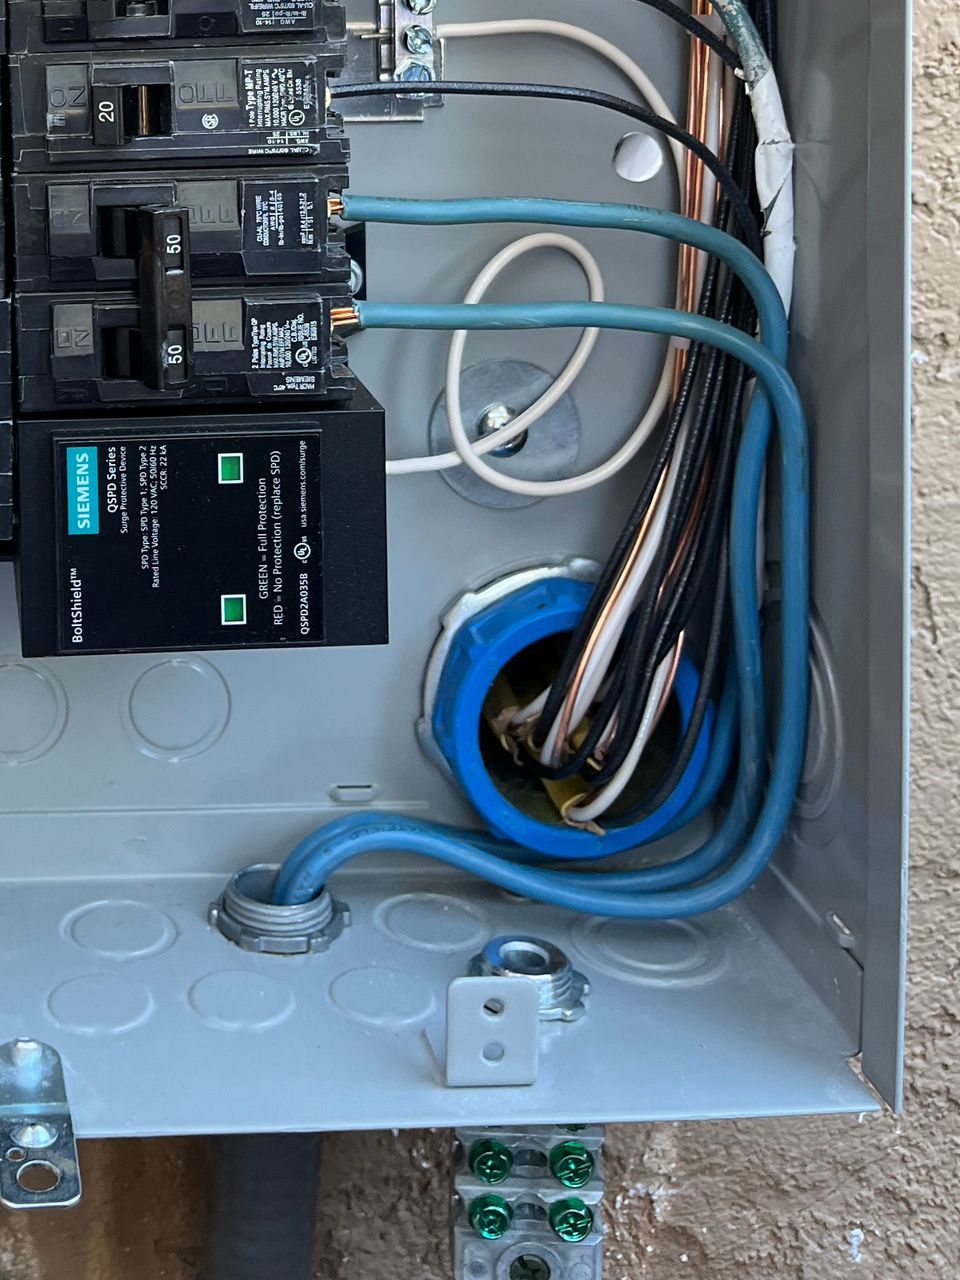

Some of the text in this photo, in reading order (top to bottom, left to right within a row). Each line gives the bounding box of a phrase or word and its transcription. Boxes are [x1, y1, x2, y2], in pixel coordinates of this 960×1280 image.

[244, 70, 253, 89] MP-T
[246, 91, 257, 110] Type
[99, 102, 114, 122] 20
[167, 235, 181, 253] 50
[167, 344, 184, 366] 50
[150, 446, 156, 455] Hz
[160, 445, 166, 454] kA
[139, 453, 148, 470] Type
[160, 457, 167, 466] 22
[270, 451, 281, 474] SPD)
[106, 447, 118, 512] QSPD Series
[299, 441, 307, 527] usa.siemens.com/surge
[76, 453, 90, 528] SIEMENS
[271, 478, 283, 519] (replace
[140, 498, 149, 515] Type
[257, 478, 267, 530] Protection
[120, 512, 129, 533] Surge
[258, 534, 267, 551] Full
[272, 523, 282, 574] Protection
[141, 555, 149, 569] SPD
[259, 565, 268, 599] GREEN
[273, 578, 282, 592] No
[300, 573, 310, 634] QSPD2A035B
[274, 605, 283, 624] RED
